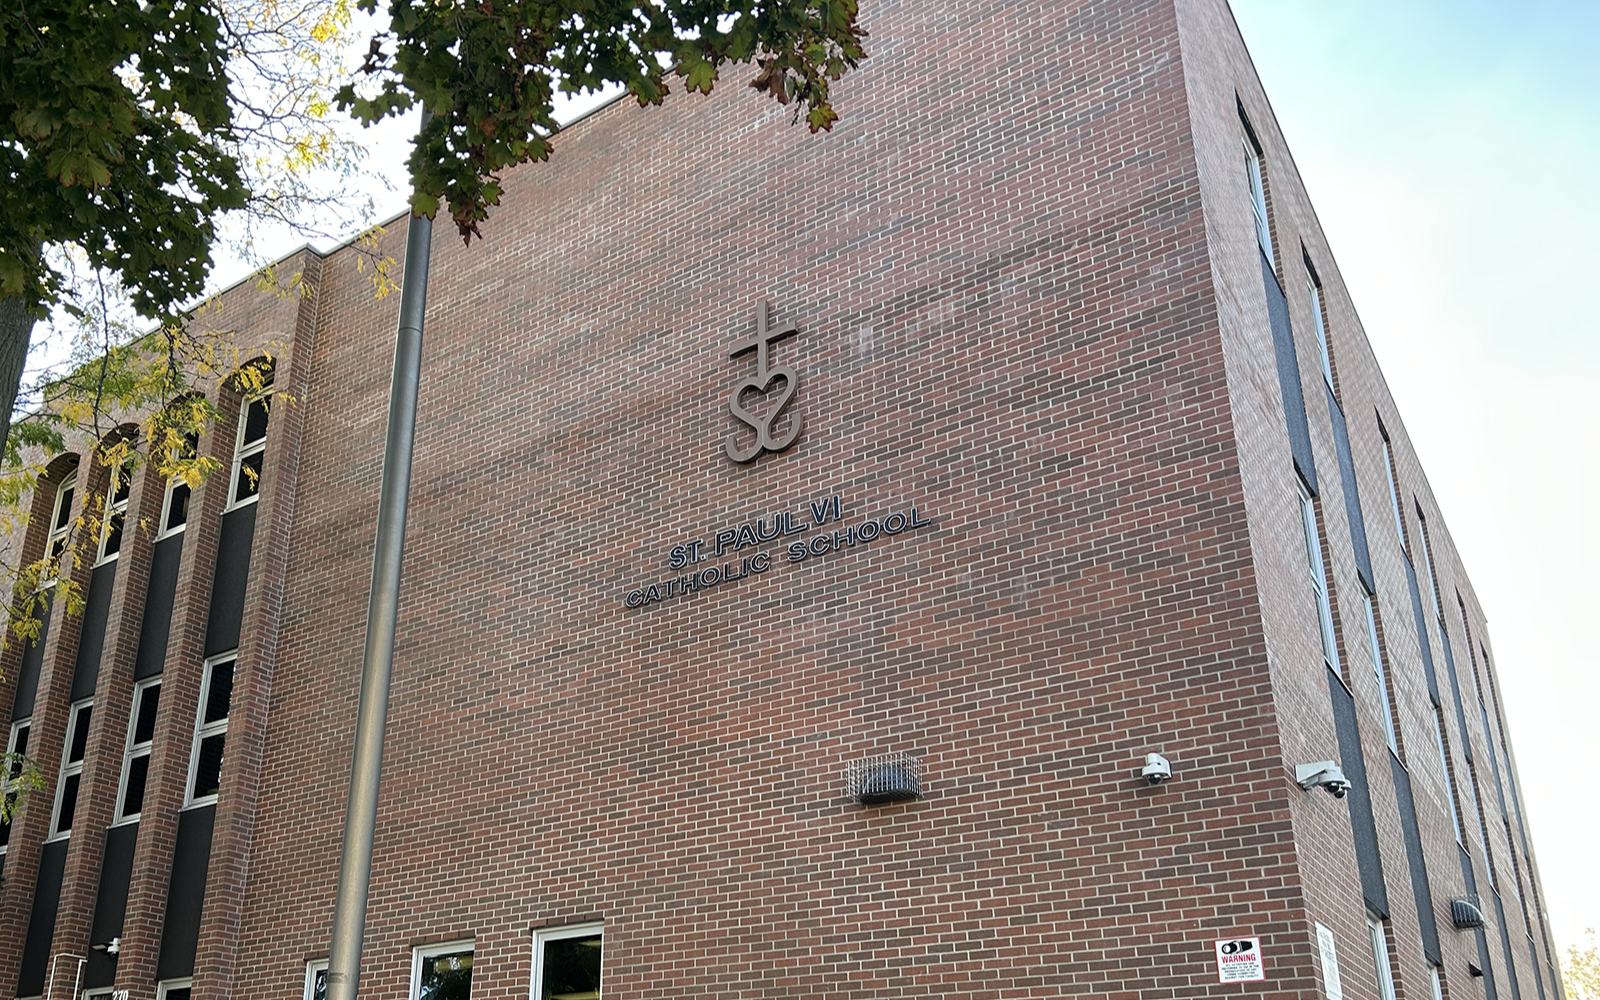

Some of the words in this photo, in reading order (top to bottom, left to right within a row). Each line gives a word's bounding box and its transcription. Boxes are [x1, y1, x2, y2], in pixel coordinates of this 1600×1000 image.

[625, 551, 771, 608] CATHOLIC
[787, 506, 932, 562] SCHOOL
[669, 538, 708, 569] ST.
[715, 510, 808, 556] PAUL
[810, 495, 841, 524] VI
[1221, 953, 1256, 963] WARNING
